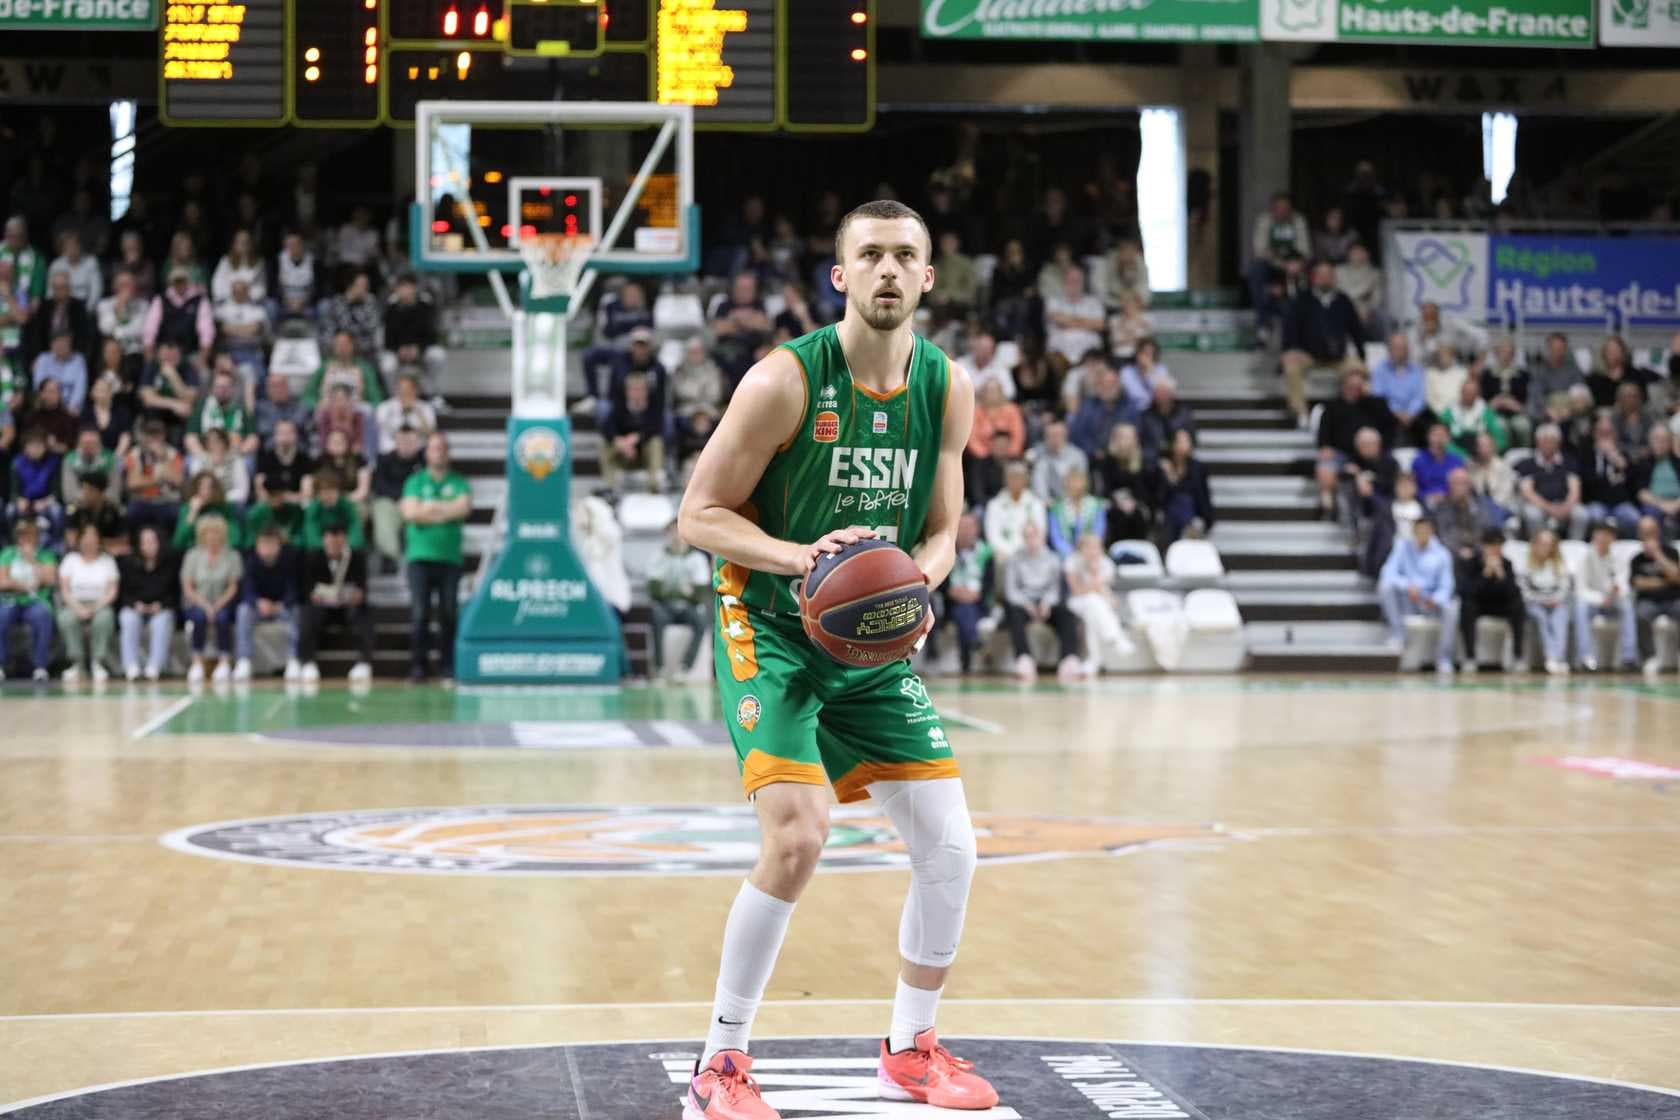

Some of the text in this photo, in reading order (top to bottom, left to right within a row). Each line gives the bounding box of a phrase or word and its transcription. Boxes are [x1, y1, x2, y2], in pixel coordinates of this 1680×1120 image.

[1341, 6, 1589, 38] Hauts-de-France
[1495, 244, 1596, 277] Région
[815, 427, 838, 436] KING
